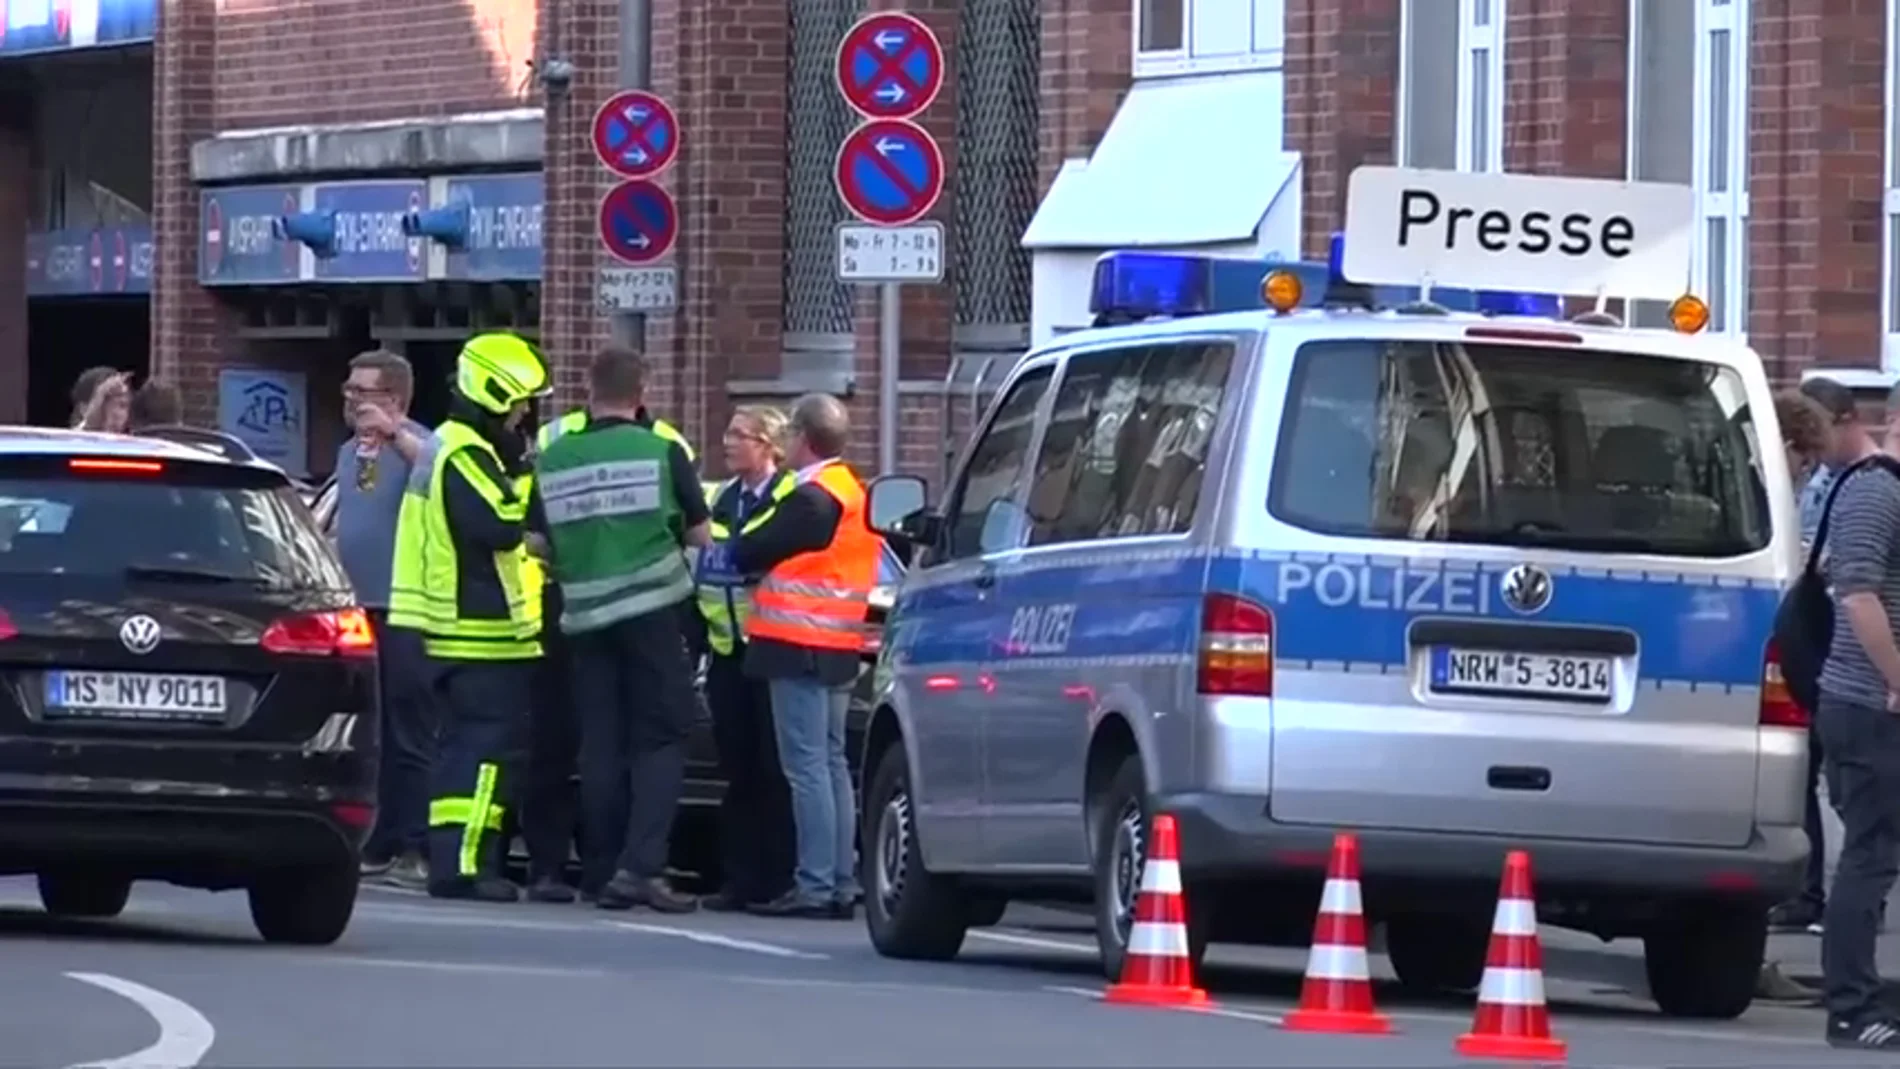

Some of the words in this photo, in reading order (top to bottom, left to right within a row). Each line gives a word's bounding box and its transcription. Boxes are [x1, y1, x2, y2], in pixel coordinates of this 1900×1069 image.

[1397, 189, 1635, 259] Presse
[1277, 561, 1491, 615] POLIZEI
[1006, 603, 1078, 656] POLIZEI
[63, 674, 99, 704] MS
[118, 676, 150, 706] NY
[158, 678, 223, 709] 9011
[1449, 653, 1500, 684] NRW
